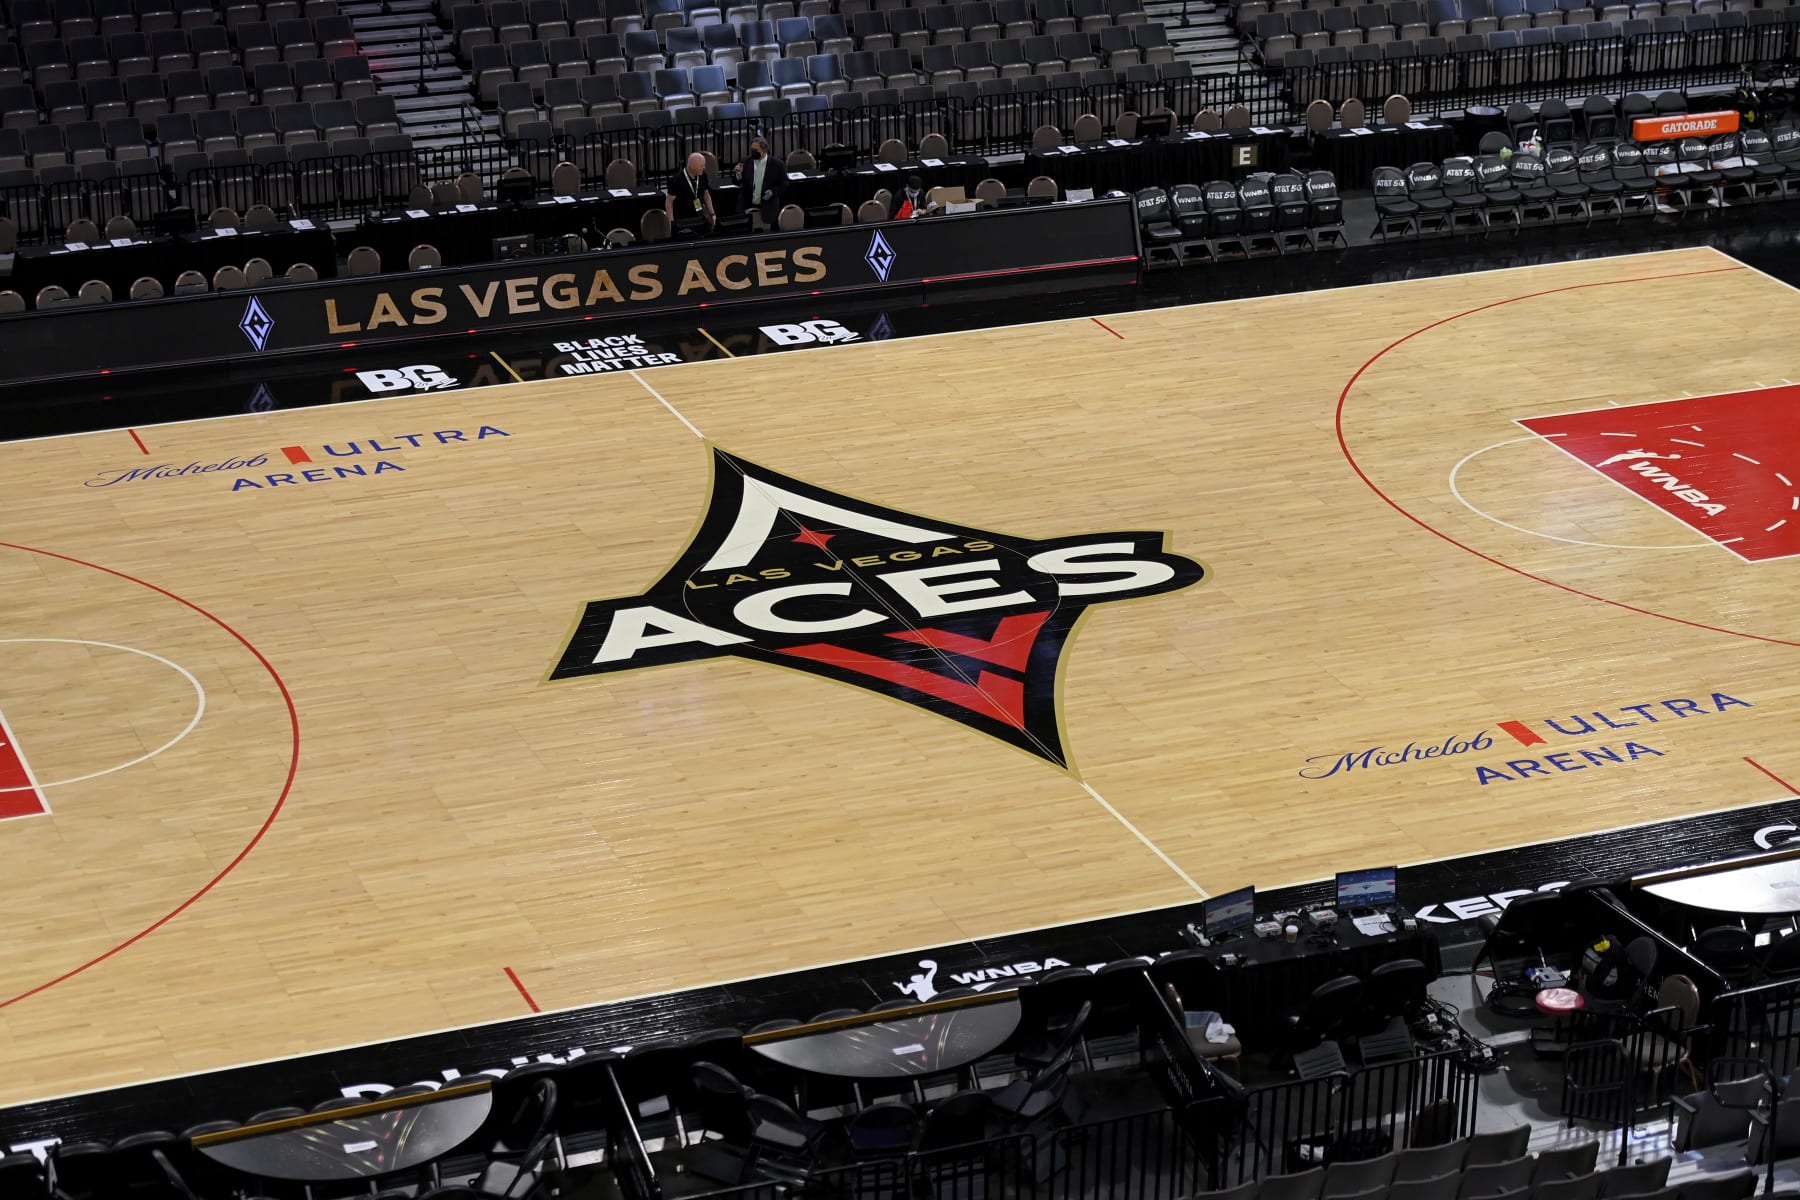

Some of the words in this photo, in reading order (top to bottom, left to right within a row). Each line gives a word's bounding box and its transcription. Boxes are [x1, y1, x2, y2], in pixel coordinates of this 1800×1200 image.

[1662, 119, 1718, 133] GATORADE
[1239, 146, 1251, 165] E
[325, 287, 448, 334] LAS
[459, 263, 664, 318] VEGAS
[677, 246, 828, 296] ACES
[553, 334, 647, 353] BLACK
[570, 345, 649, 362] LIVES
[560, 352, 683, 375] MATTER
[84, 453, 271, 488] Michelob
[322, 425, 511, 457] ULTRA
[231, 460, 406, 492] ARENA
[1628, 461, 1727, 517] WNBA
[685, 568, 791, 590] LAS
[813, 540, 995, 572] VEGAS
[592, 541, 1176, 665] ACES
[1298, 730, 1494, 780] Michelob
[1544, 692, 1755, 736] ULTRA
[1475, 741, 1666, 786] ARENA
[949, 957, 1072, 985] WNBA
